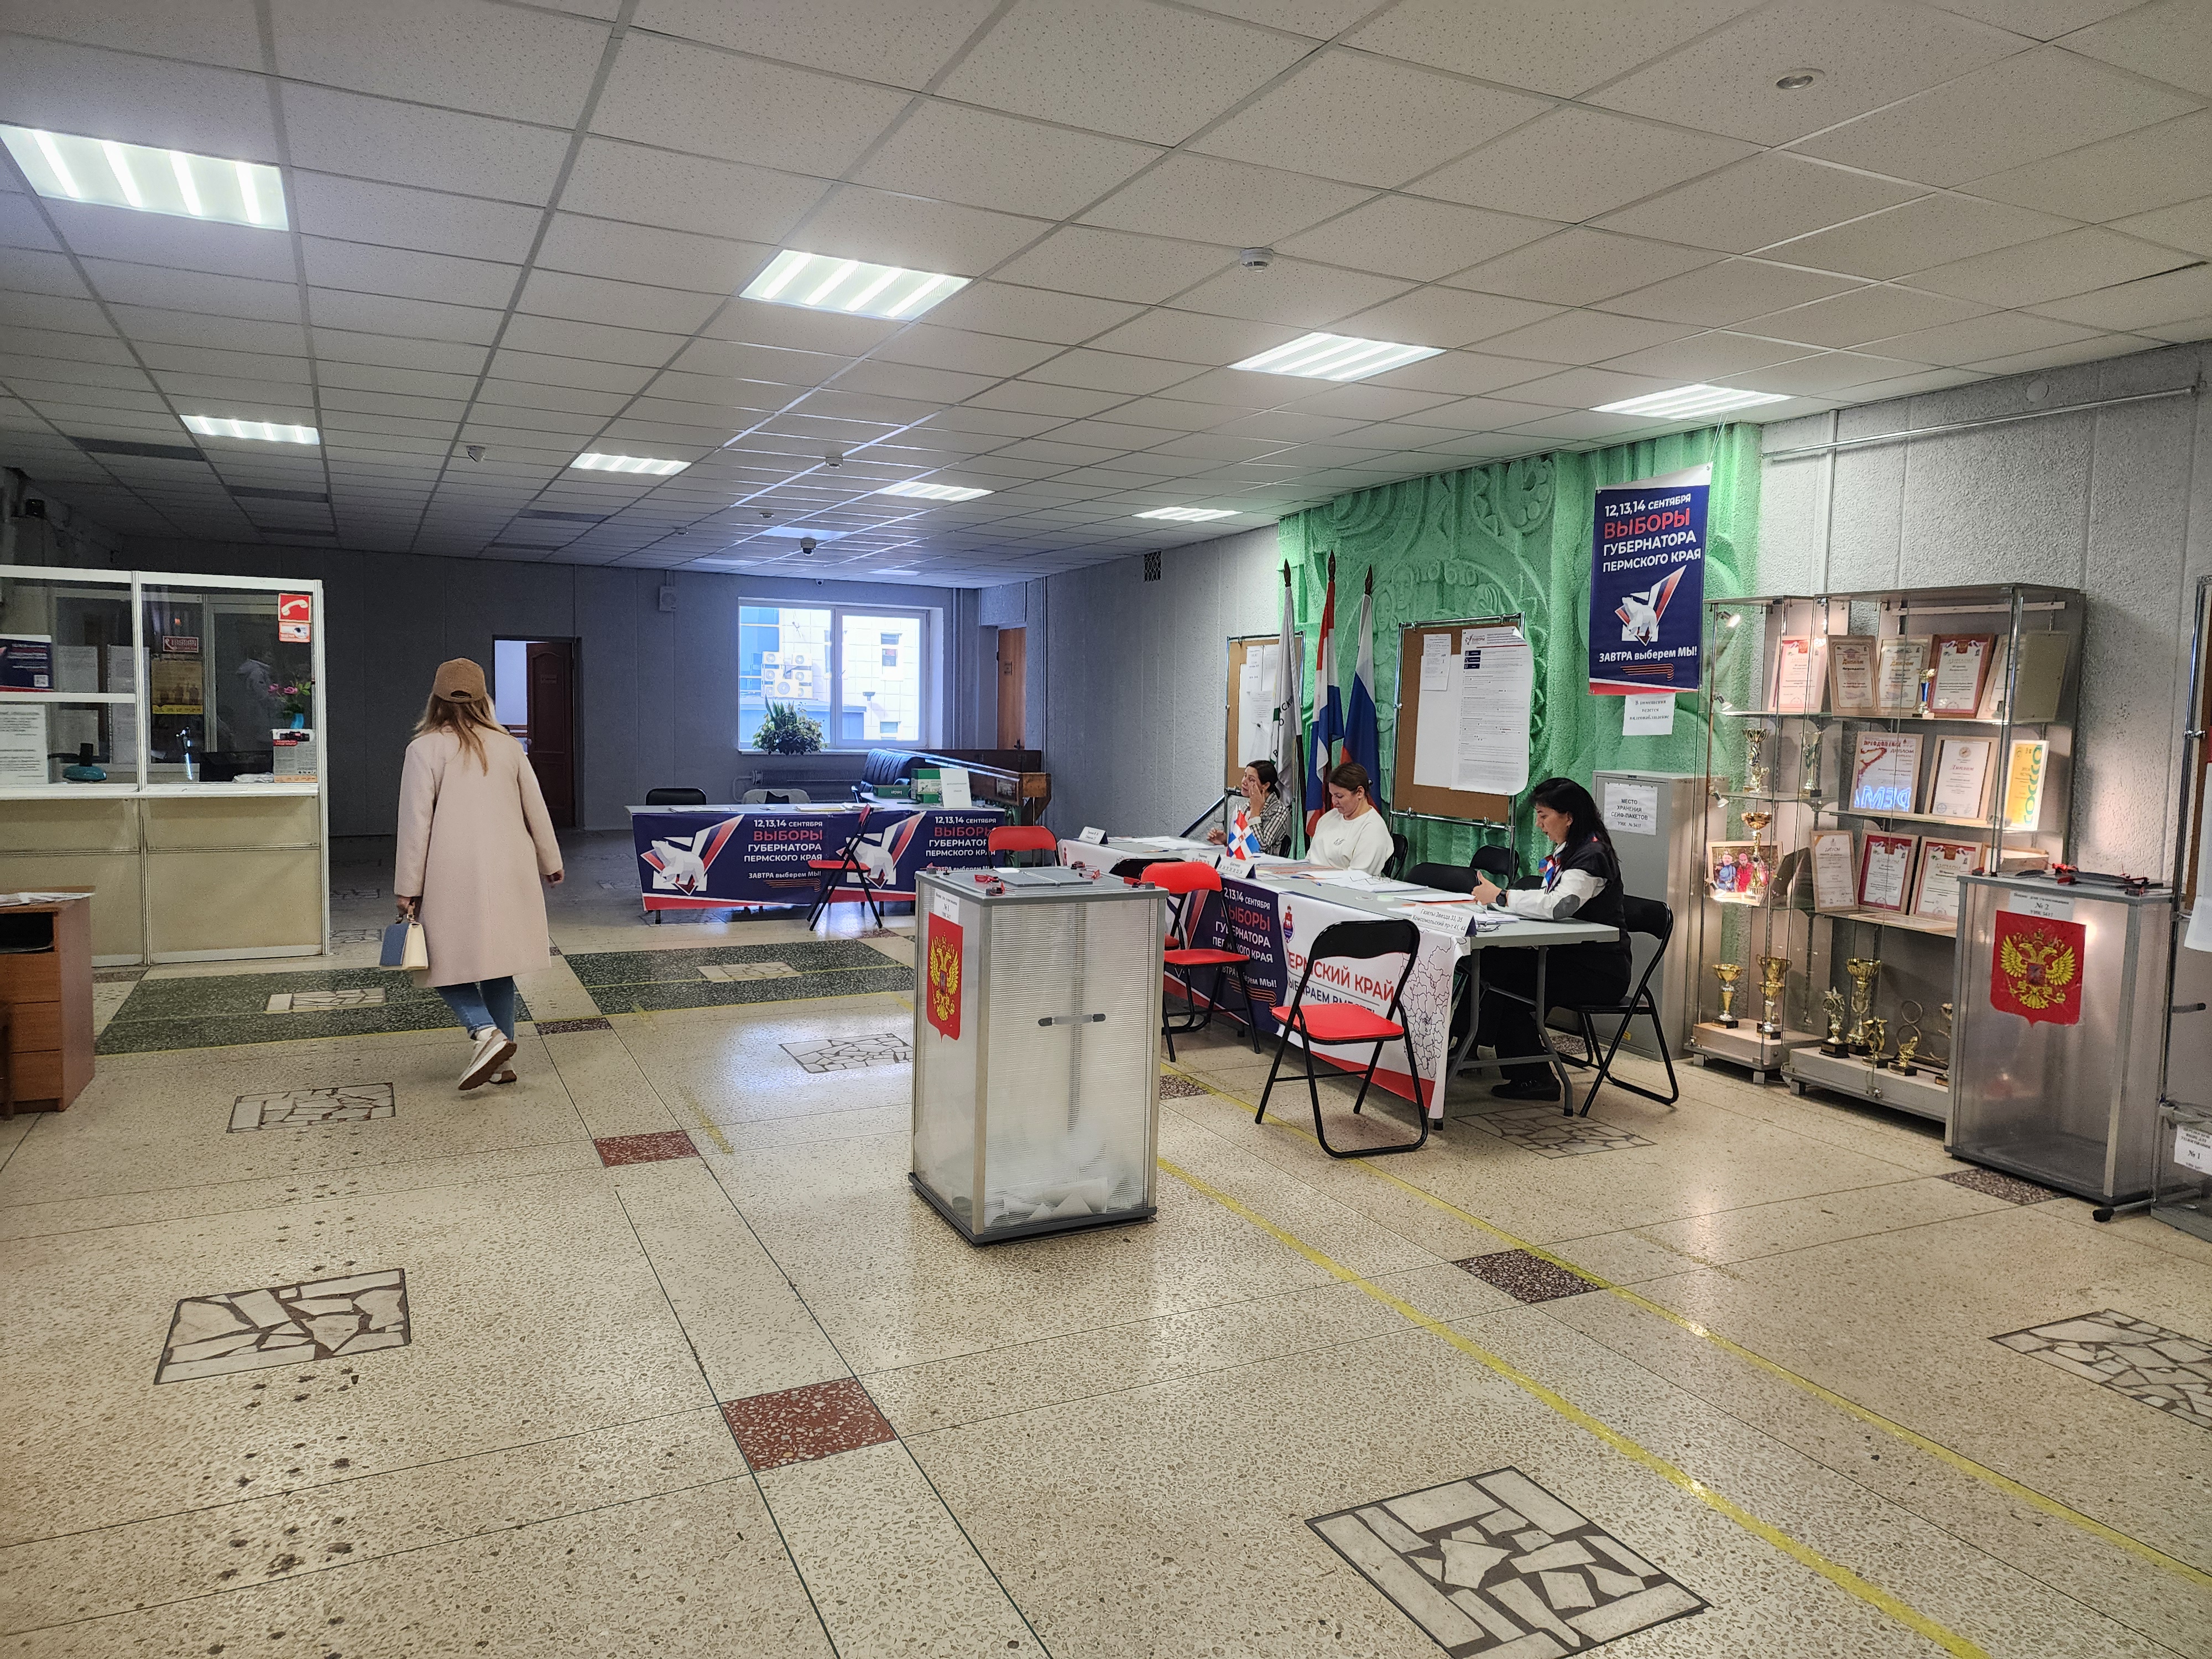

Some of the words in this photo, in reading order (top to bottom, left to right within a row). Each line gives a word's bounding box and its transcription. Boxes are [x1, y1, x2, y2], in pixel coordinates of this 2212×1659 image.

[1605, 500, 1646, 518] 12,13,14
[1648, 493, 1691, 510] СЕНТЯБРЯ
[1604, 508, 1690, 539] ВЫБОРЫ
[1604, 530, 1697, 556] ГУБЕРНАТОРА
[1603, 554, 1668, 572] ПЕРМСКОГО
[1671, 548, 1701, 563] КРАЯ
[1599, 651, 1632, 662] ЗАВТРА
[1634, 649, 1676, 661] выберем
[1678, 646, 1697, 657] МЫ!
[935, 816, 964, 825] 12,13,14
[1611, 811, 1648, 821] СЕЙФ-ПАКЕТОВ
[754, 820, 786, 828] 12,13,14
[753, 830, 823, 841] ВЫБОРЫ
[748, 843, 822, 852] ГУБЕРНАТОРА
[1245, 896, 1270, 911] СЕНТЯБРЯ
[1412, 915, 1444, 927] Комсомольский
[1436, 912, 1450, 920] Звезда
[1251, 949, 1274, 963] КРАЯ
[1259, 977, 1277, 988] МЫ!
[1355, 974, 1394, 1002] КРАЙ
[2188, 1150, 2195, 1158] №
